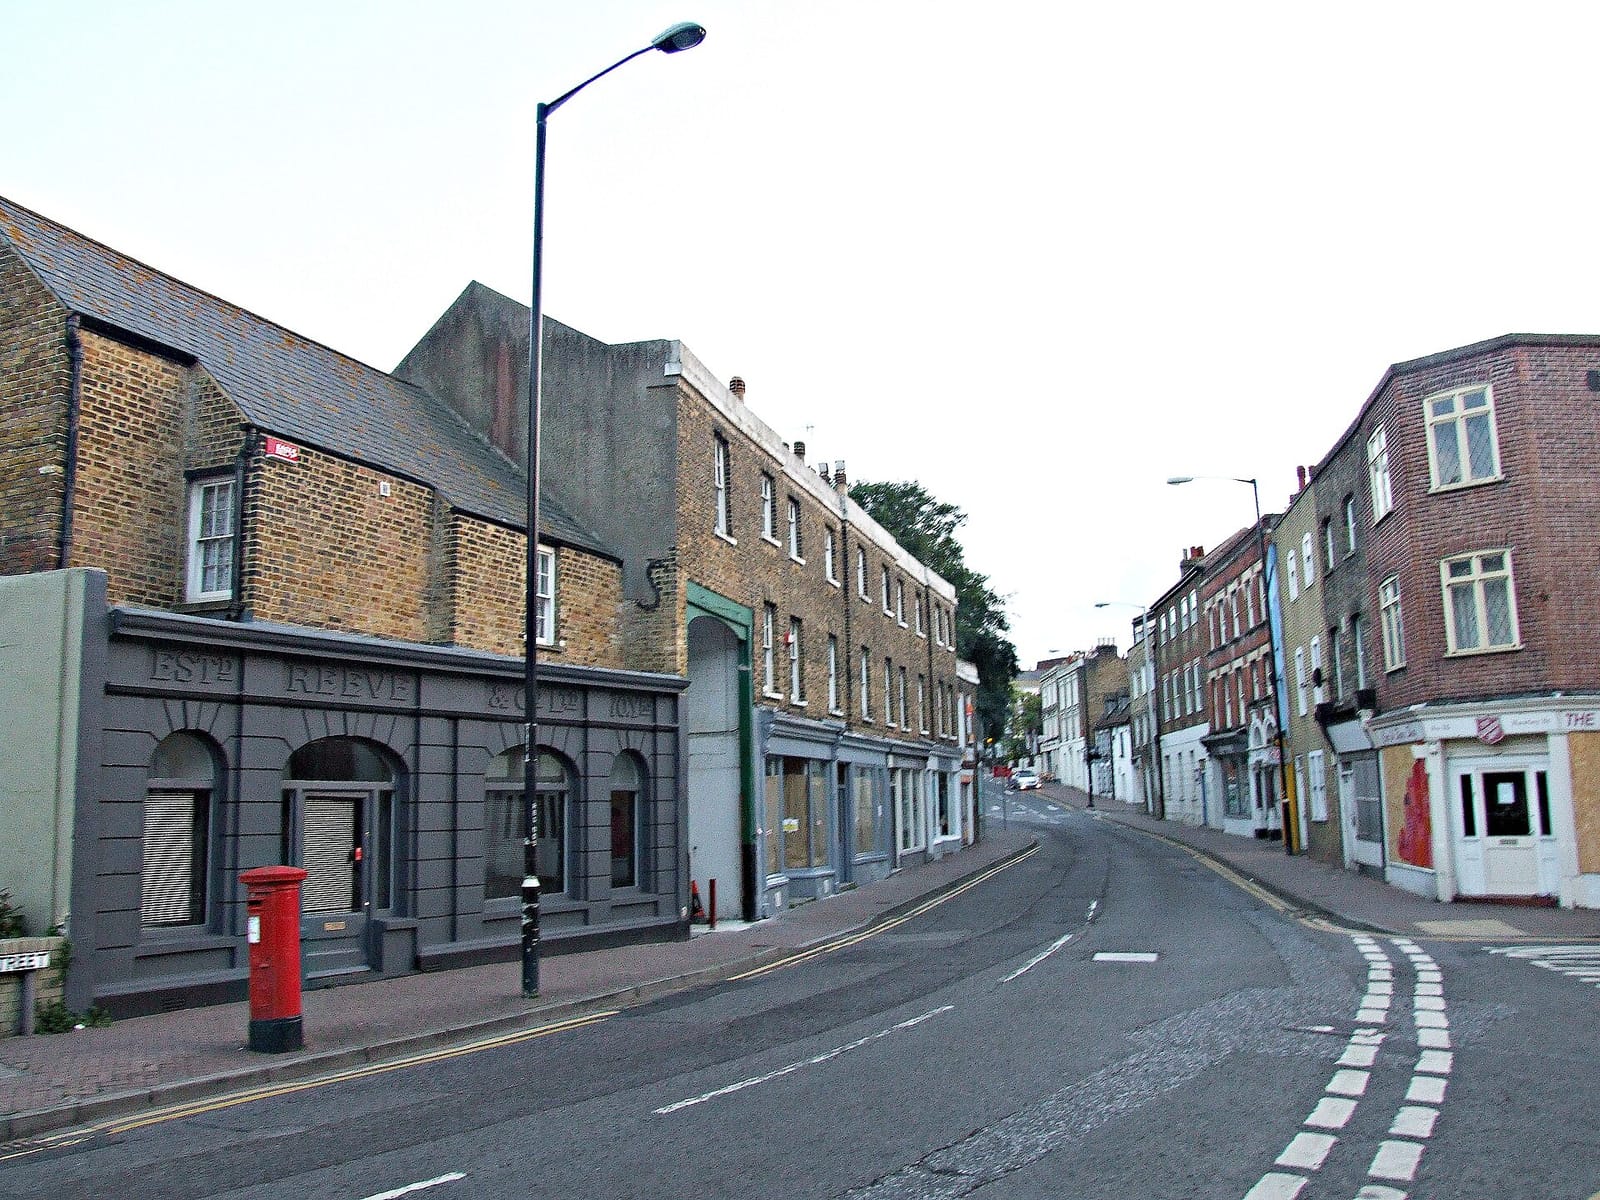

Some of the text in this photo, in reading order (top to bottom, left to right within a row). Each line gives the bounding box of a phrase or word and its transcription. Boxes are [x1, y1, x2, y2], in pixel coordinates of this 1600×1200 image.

[285, 661, 408, 701] REEVE
[488, 685, 508, 709] &
[1565, 711, 1596, 727] THE
